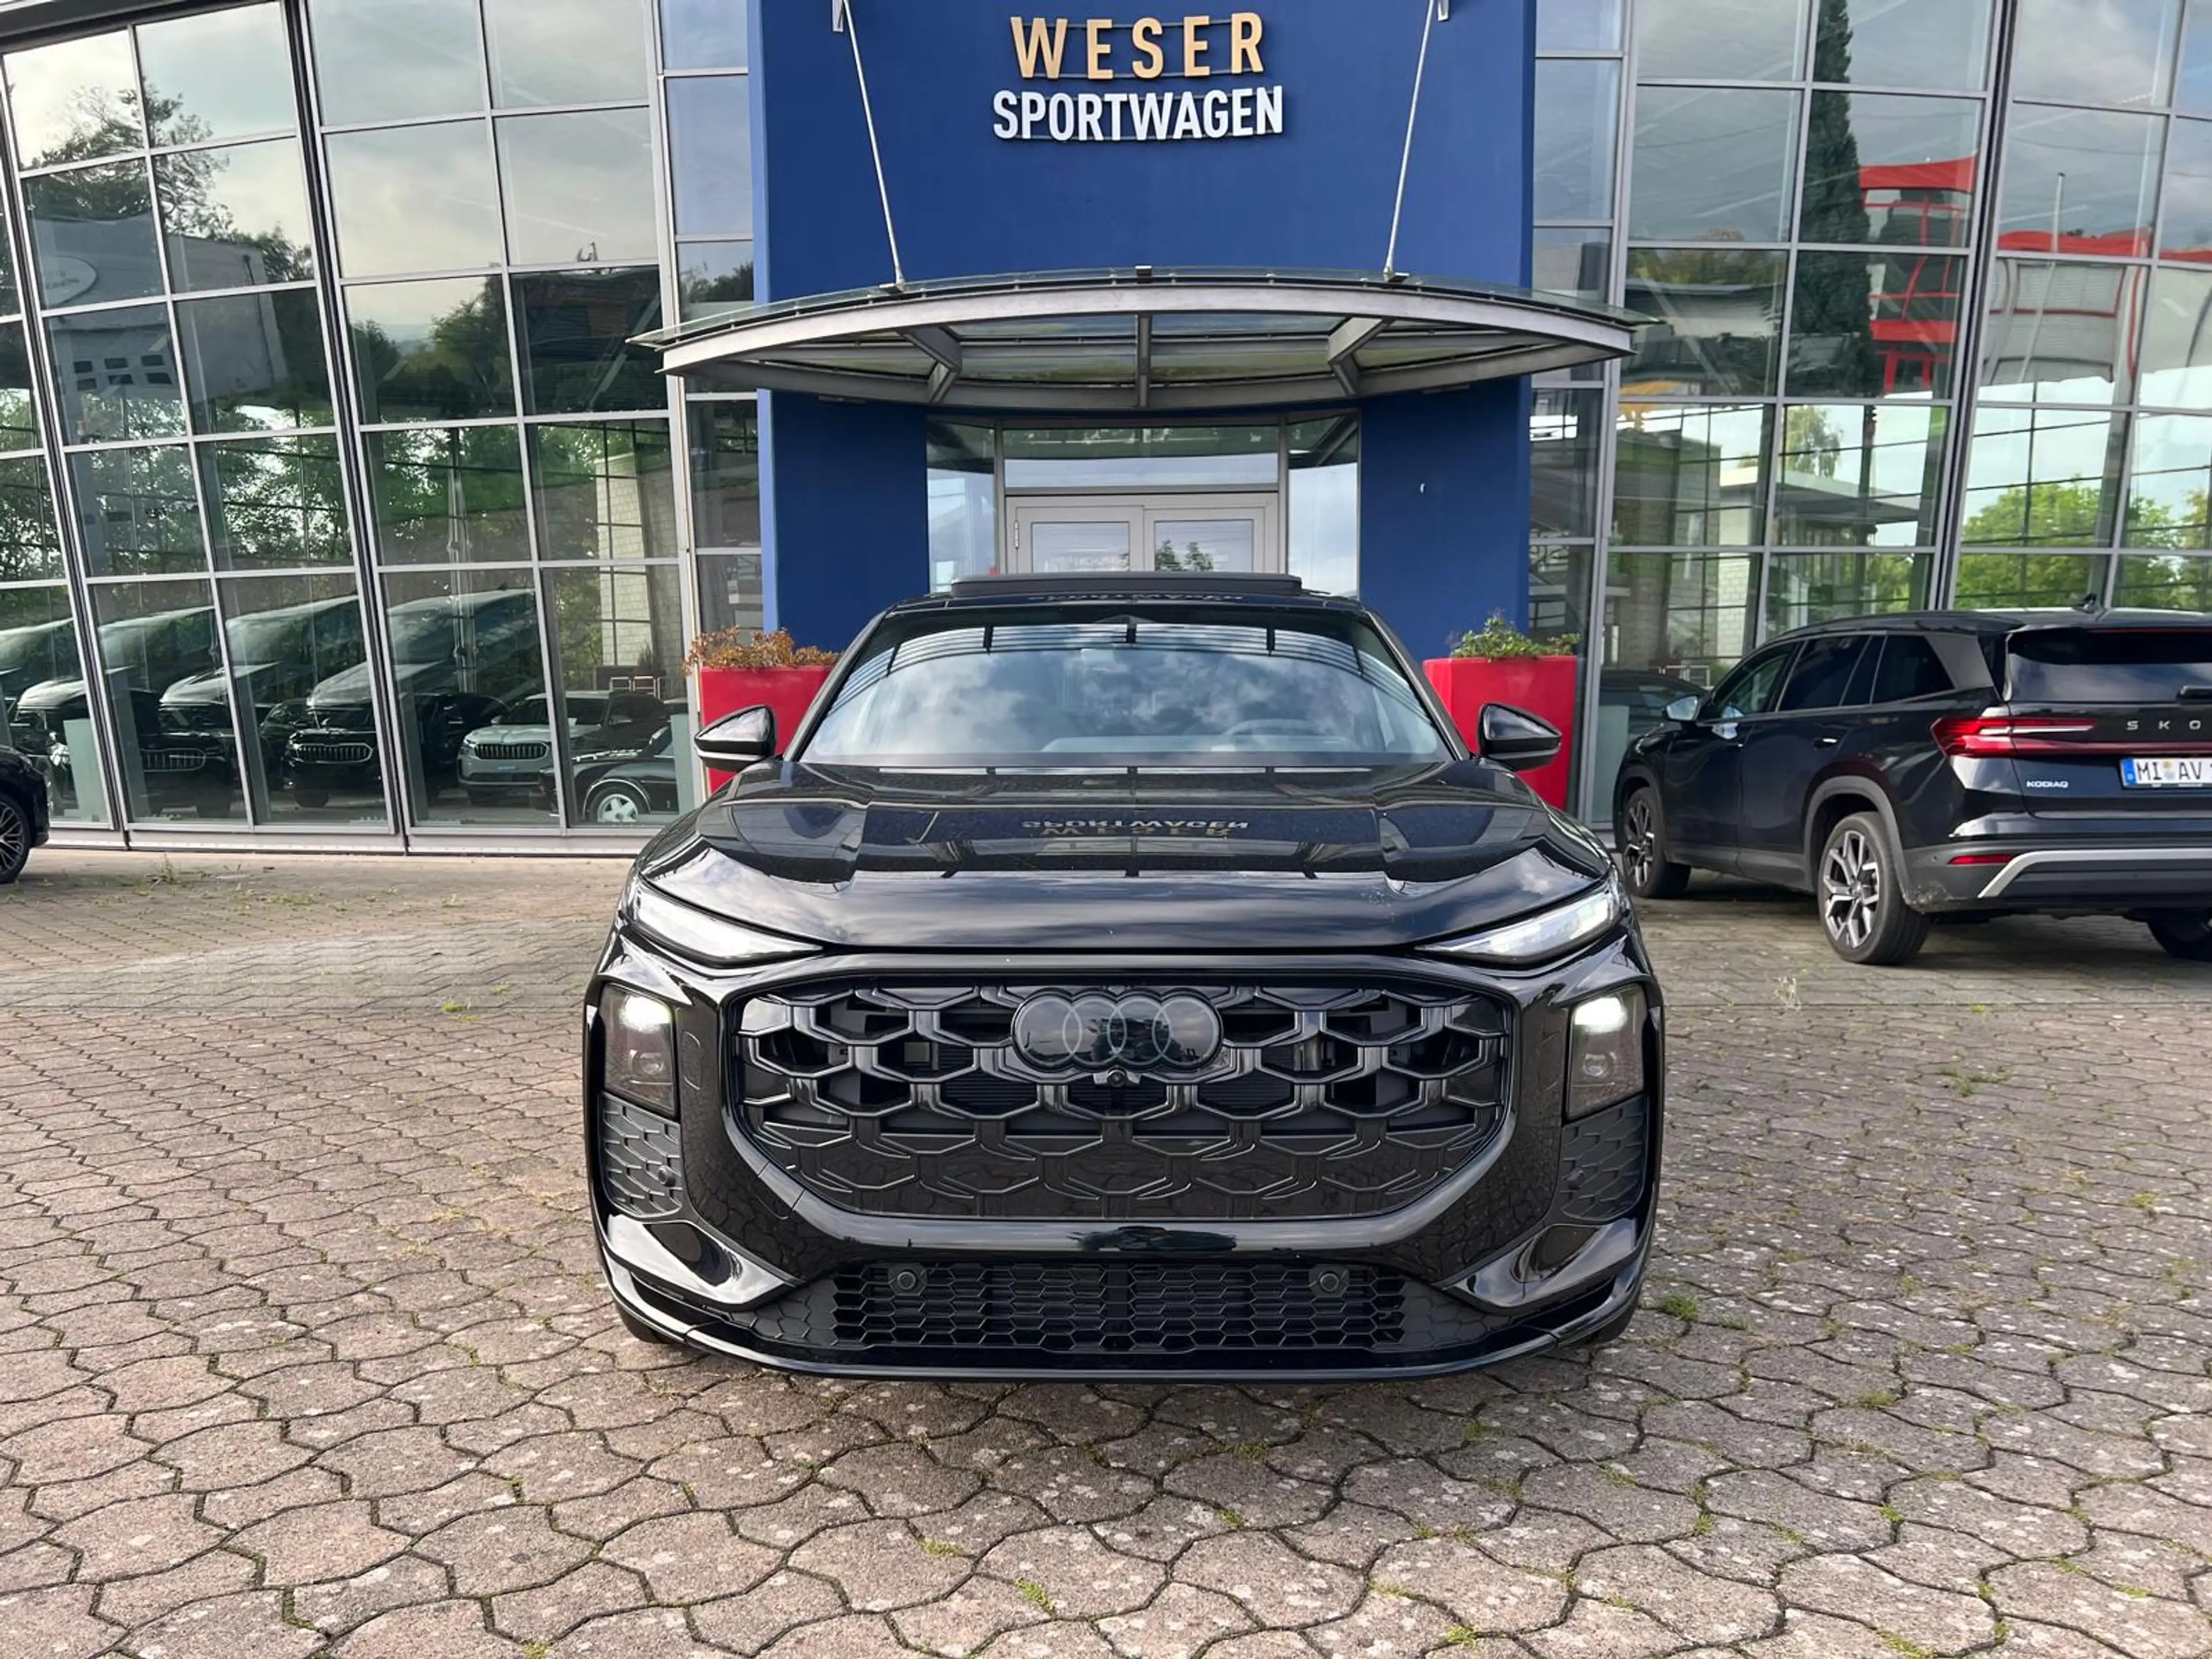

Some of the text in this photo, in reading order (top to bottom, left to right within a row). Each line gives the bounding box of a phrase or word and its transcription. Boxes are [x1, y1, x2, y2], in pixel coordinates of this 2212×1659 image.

[1010, 12, 1264, 79] WESER
[993, 85, 1283, 141] SPORTWAGEN
[2026, 781, 2069, 789] KODIAQ
[2137, 761, 2162, 781] MI
[2179, 761, 2202, 781] AV
